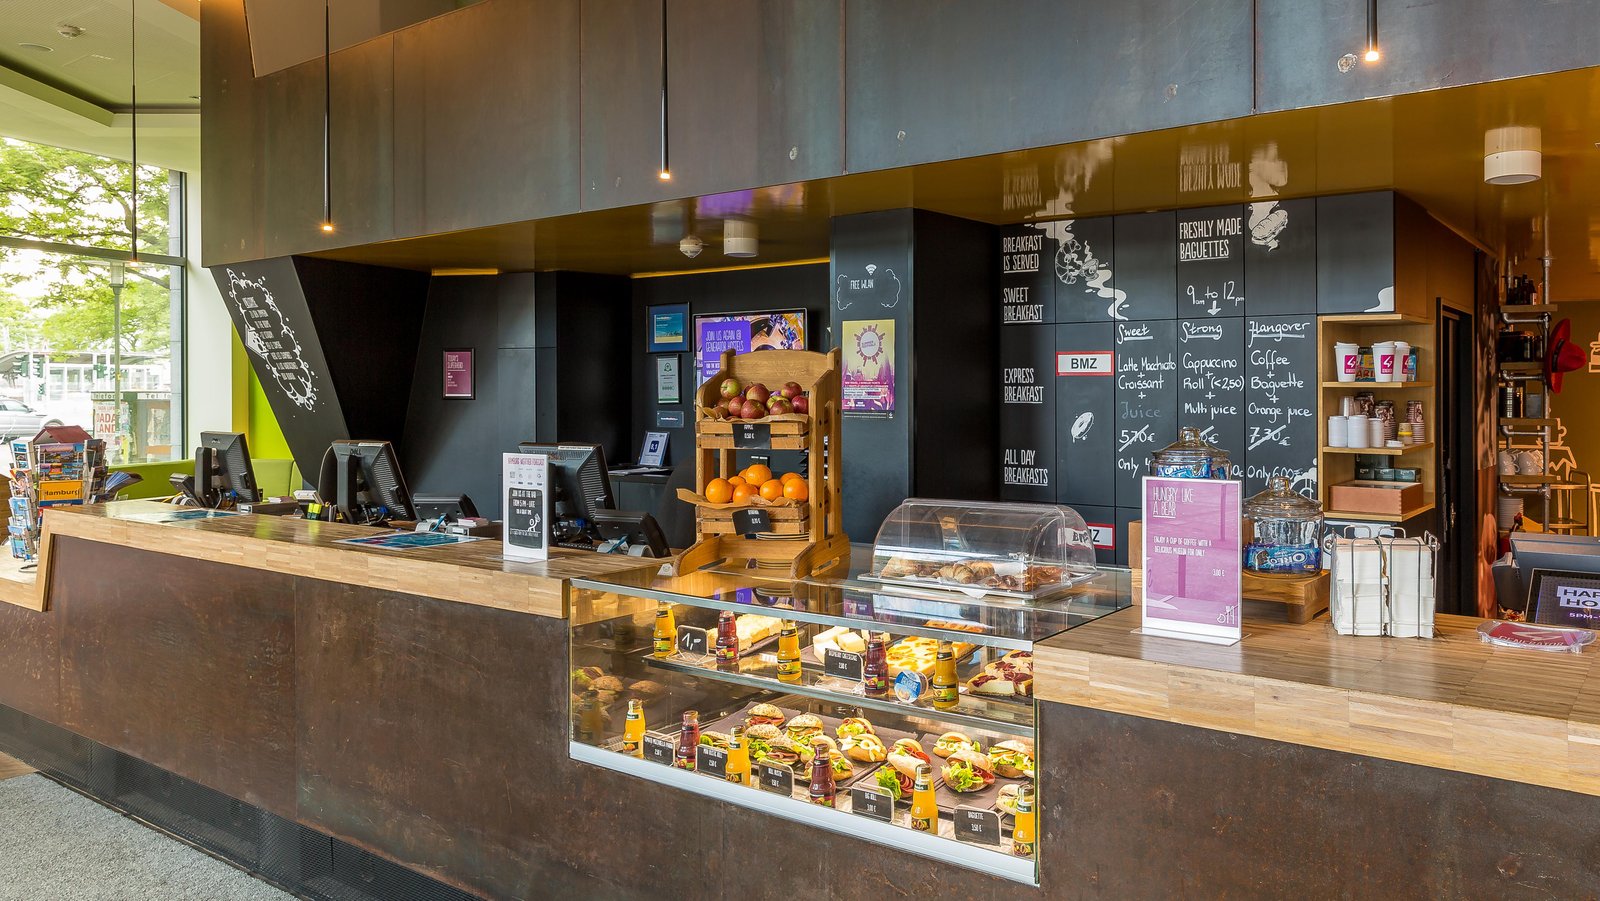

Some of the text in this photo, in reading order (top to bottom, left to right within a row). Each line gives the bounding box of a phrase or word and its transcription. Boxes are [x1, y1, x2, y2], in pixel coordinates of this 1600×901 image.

[1179, 217, 1242, 240] FRESHLY MADE
[1003, 235, 1043, 253] BREAKFAST
[1179, 239, 1230, 260] BAGUETTES
[1003, 253, 1039, 271] IS SERVED
[850, 279, 874, 290] FREE WLAN
[1205, 286, 1218, 299] to
[1003, 287, 1029, 303] SWEET
[1003, 304, 1044, 321] BREAKFAST
[705, 330, 714, 341] JOIN
[723, 329, 735, 340] AGAIN
[1116, 324, 1150, 344] Sweet
[1180, 321, 1223, 343] Strong
[1248, 321, 1310, 348] Hangover
[1071, 358, 1097, 370] BMZ
[1118, 353, 1139, 372] Latte
[1182, 352, 1238, 375] Cappuccino
[1250, 350, 1290, 370] Coffee
[1004, 367, 1035, 384] EXPRESS
[1118, 374, 1165, 390] Croissant
[1183, 377, 1204, 390] Roll
[1251, 372, 1304, 397] Baguette
[1004, 386, 1045, 402] BREAKFAST
[1121, 401, 1161, 420] Juice
[1184, 402, 1238, 420] Multi juice
[1248, 402, 1312, 423] Orange juice
[1004, 448, 1036, 465] ALL DAY
[1004, 467, 1049, 484] BREAKFASTS
[1118, 457, 1139, 479] Only
[1247, 464, 1270, 486] Only
[1153, 486, 1195, 503] HUNGRY LIKE
[1153, 501, 1177, 516] A BEAR
